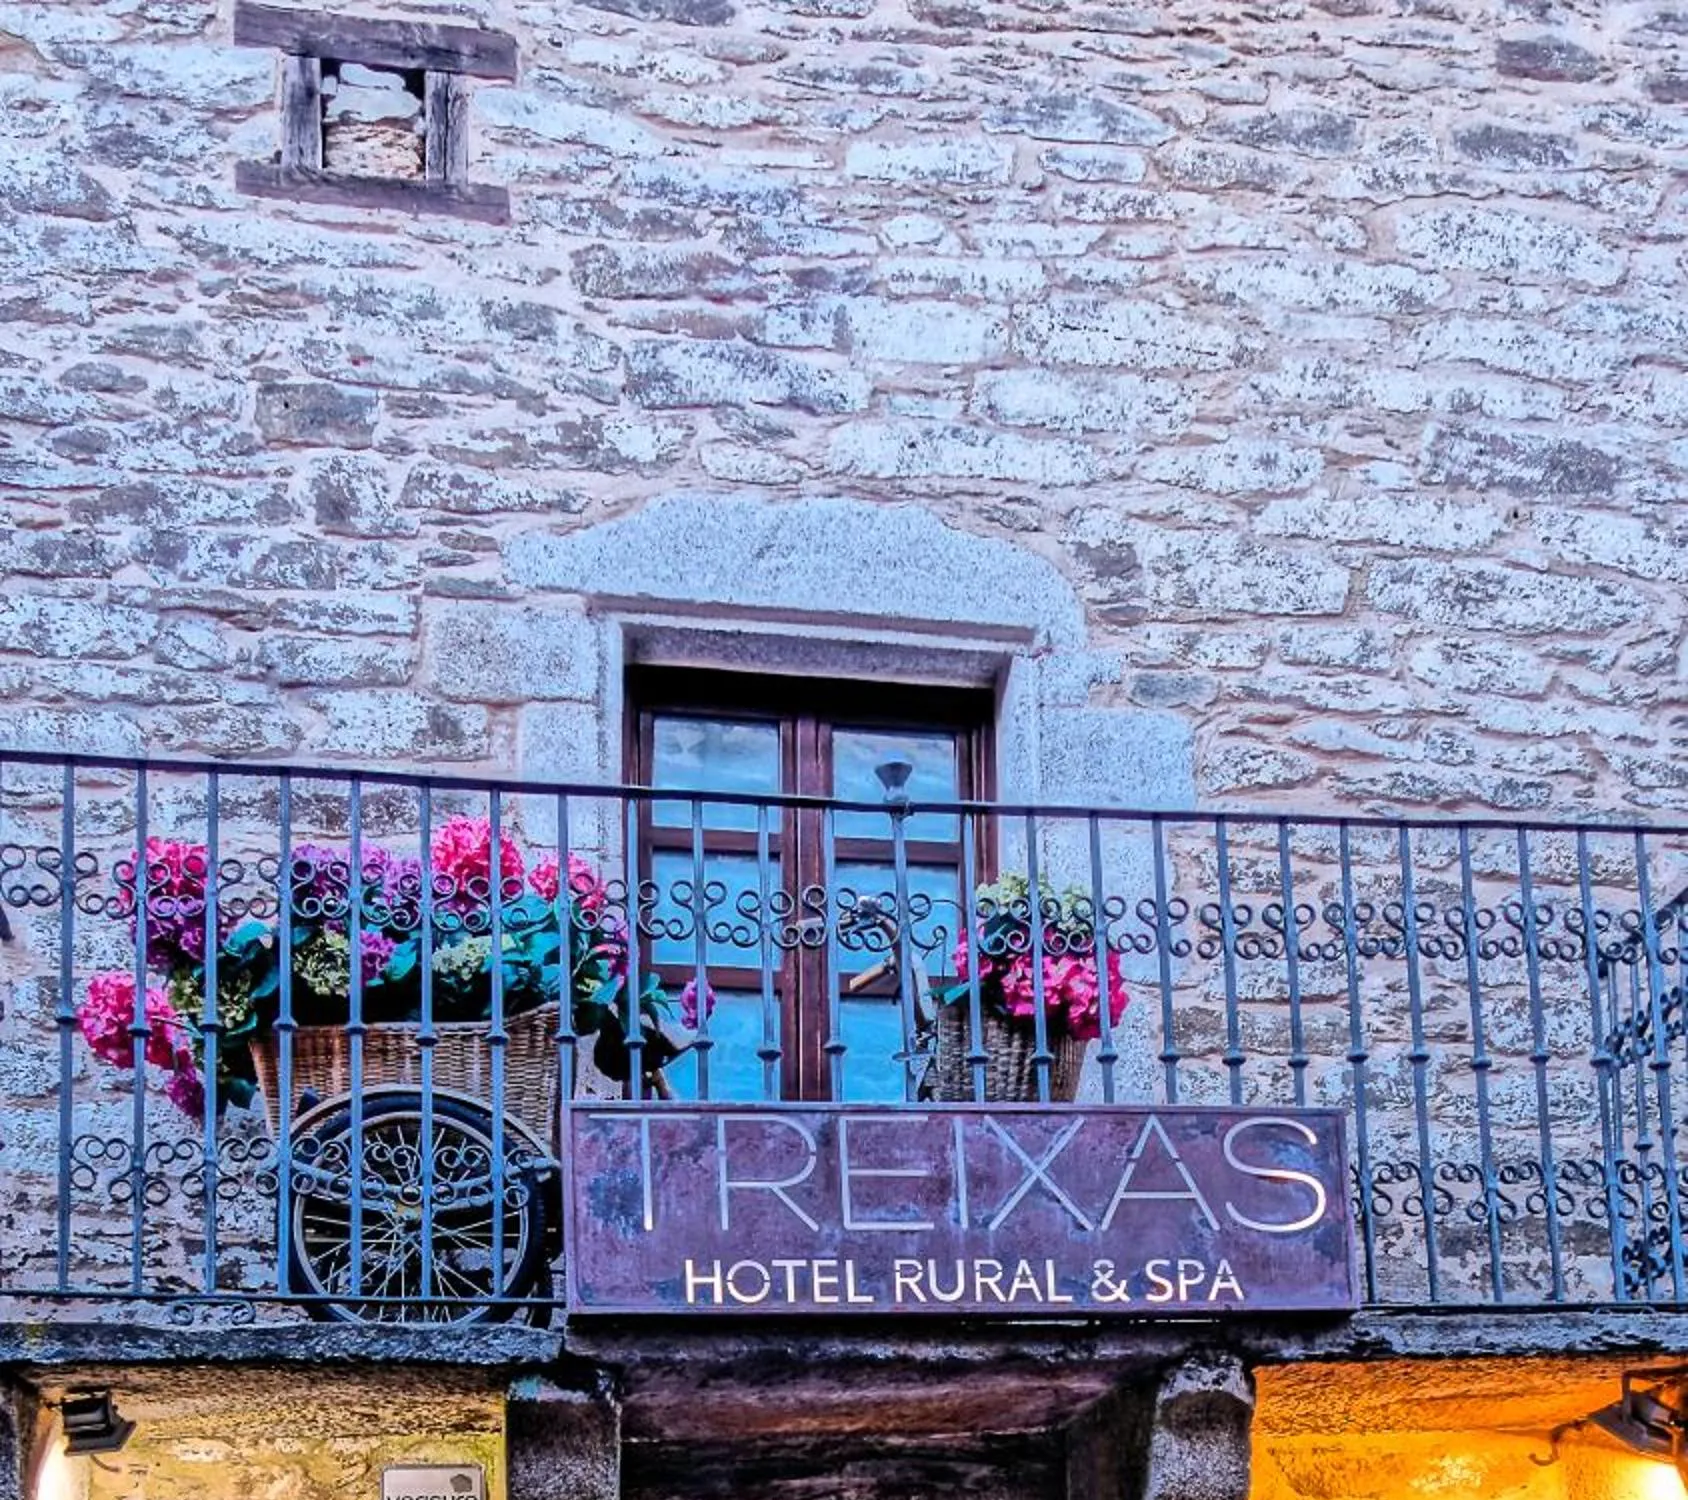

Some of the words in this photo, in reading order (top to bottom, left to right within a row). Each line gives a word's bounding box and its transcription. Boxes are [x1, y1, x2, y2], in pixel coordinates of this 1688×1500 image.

[588, 1114, 1327, 1233] TREIXAS
[685, 1258, 874, 1304] HOTEL
[894, 1258, 1073, 1303] RURAL
[1090, 1258, 1131, 1304] &
[1145, 1258, 1245, 1303] SPA
